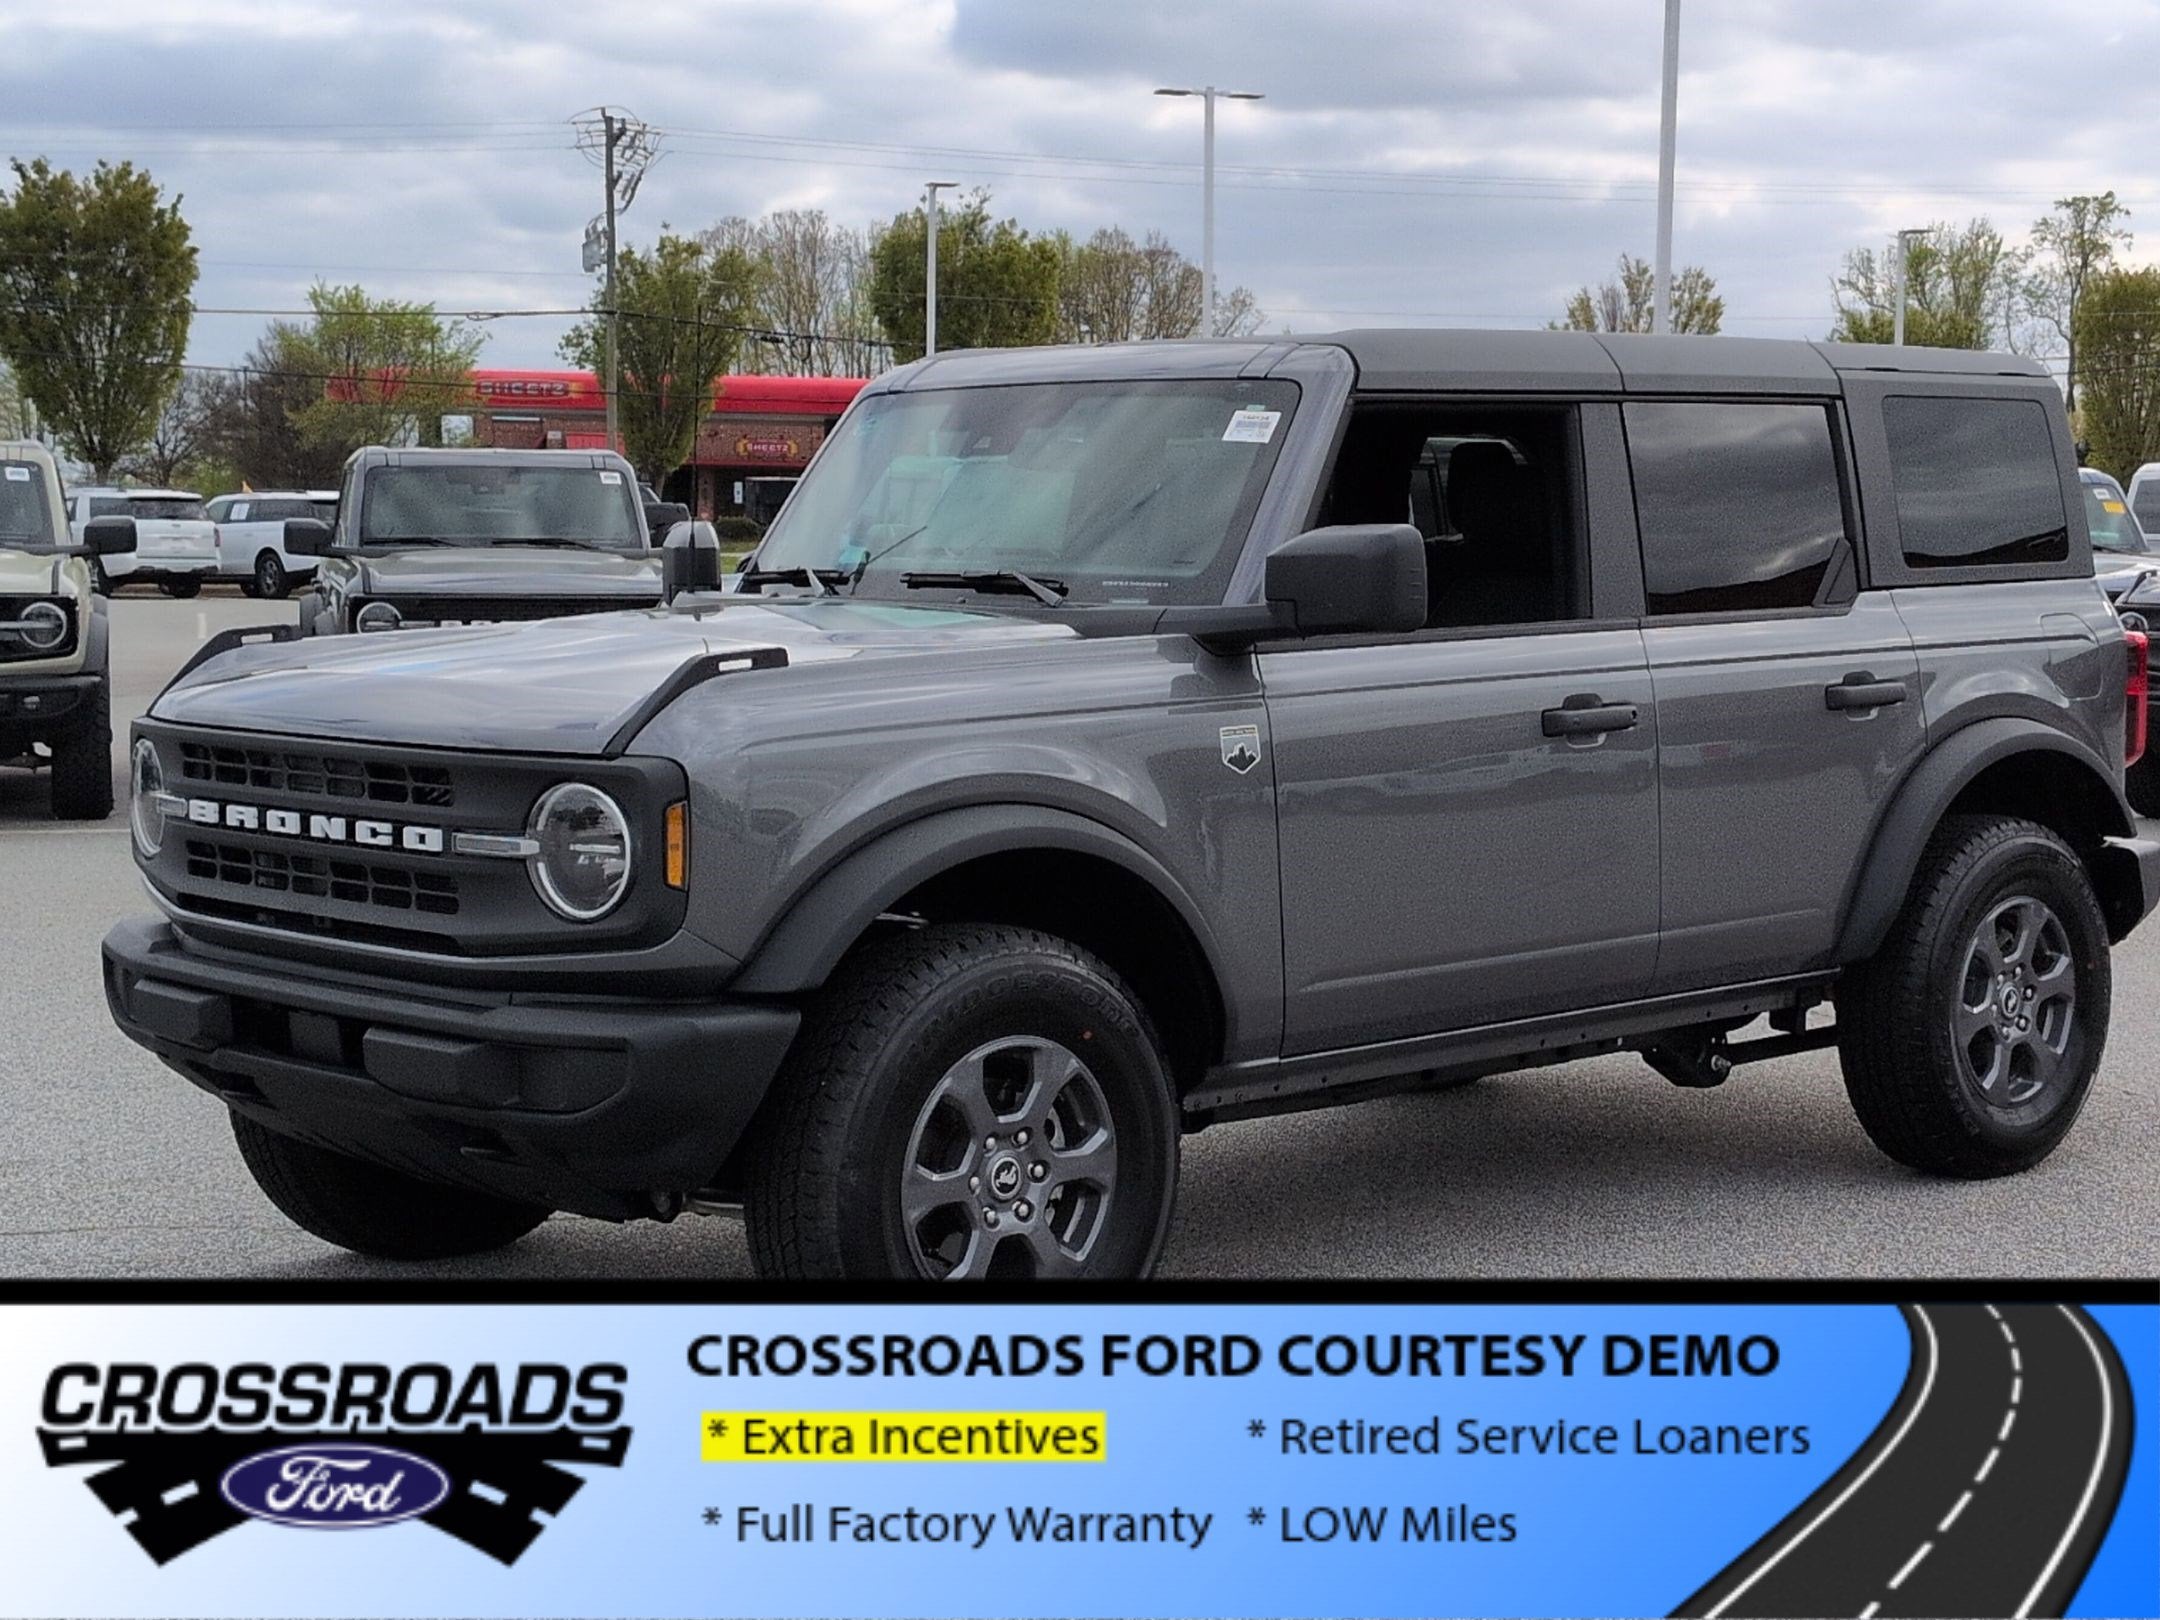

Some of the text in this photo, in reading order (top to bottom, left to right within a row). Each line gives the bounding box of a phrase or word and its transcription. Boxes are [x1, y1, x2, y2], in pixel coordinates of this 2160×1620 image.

[479, 380, 566, 396] SHEETZ
[745, 442, 789, 453] SHEETZ
[188, 798, 445, 853] BRONCO
